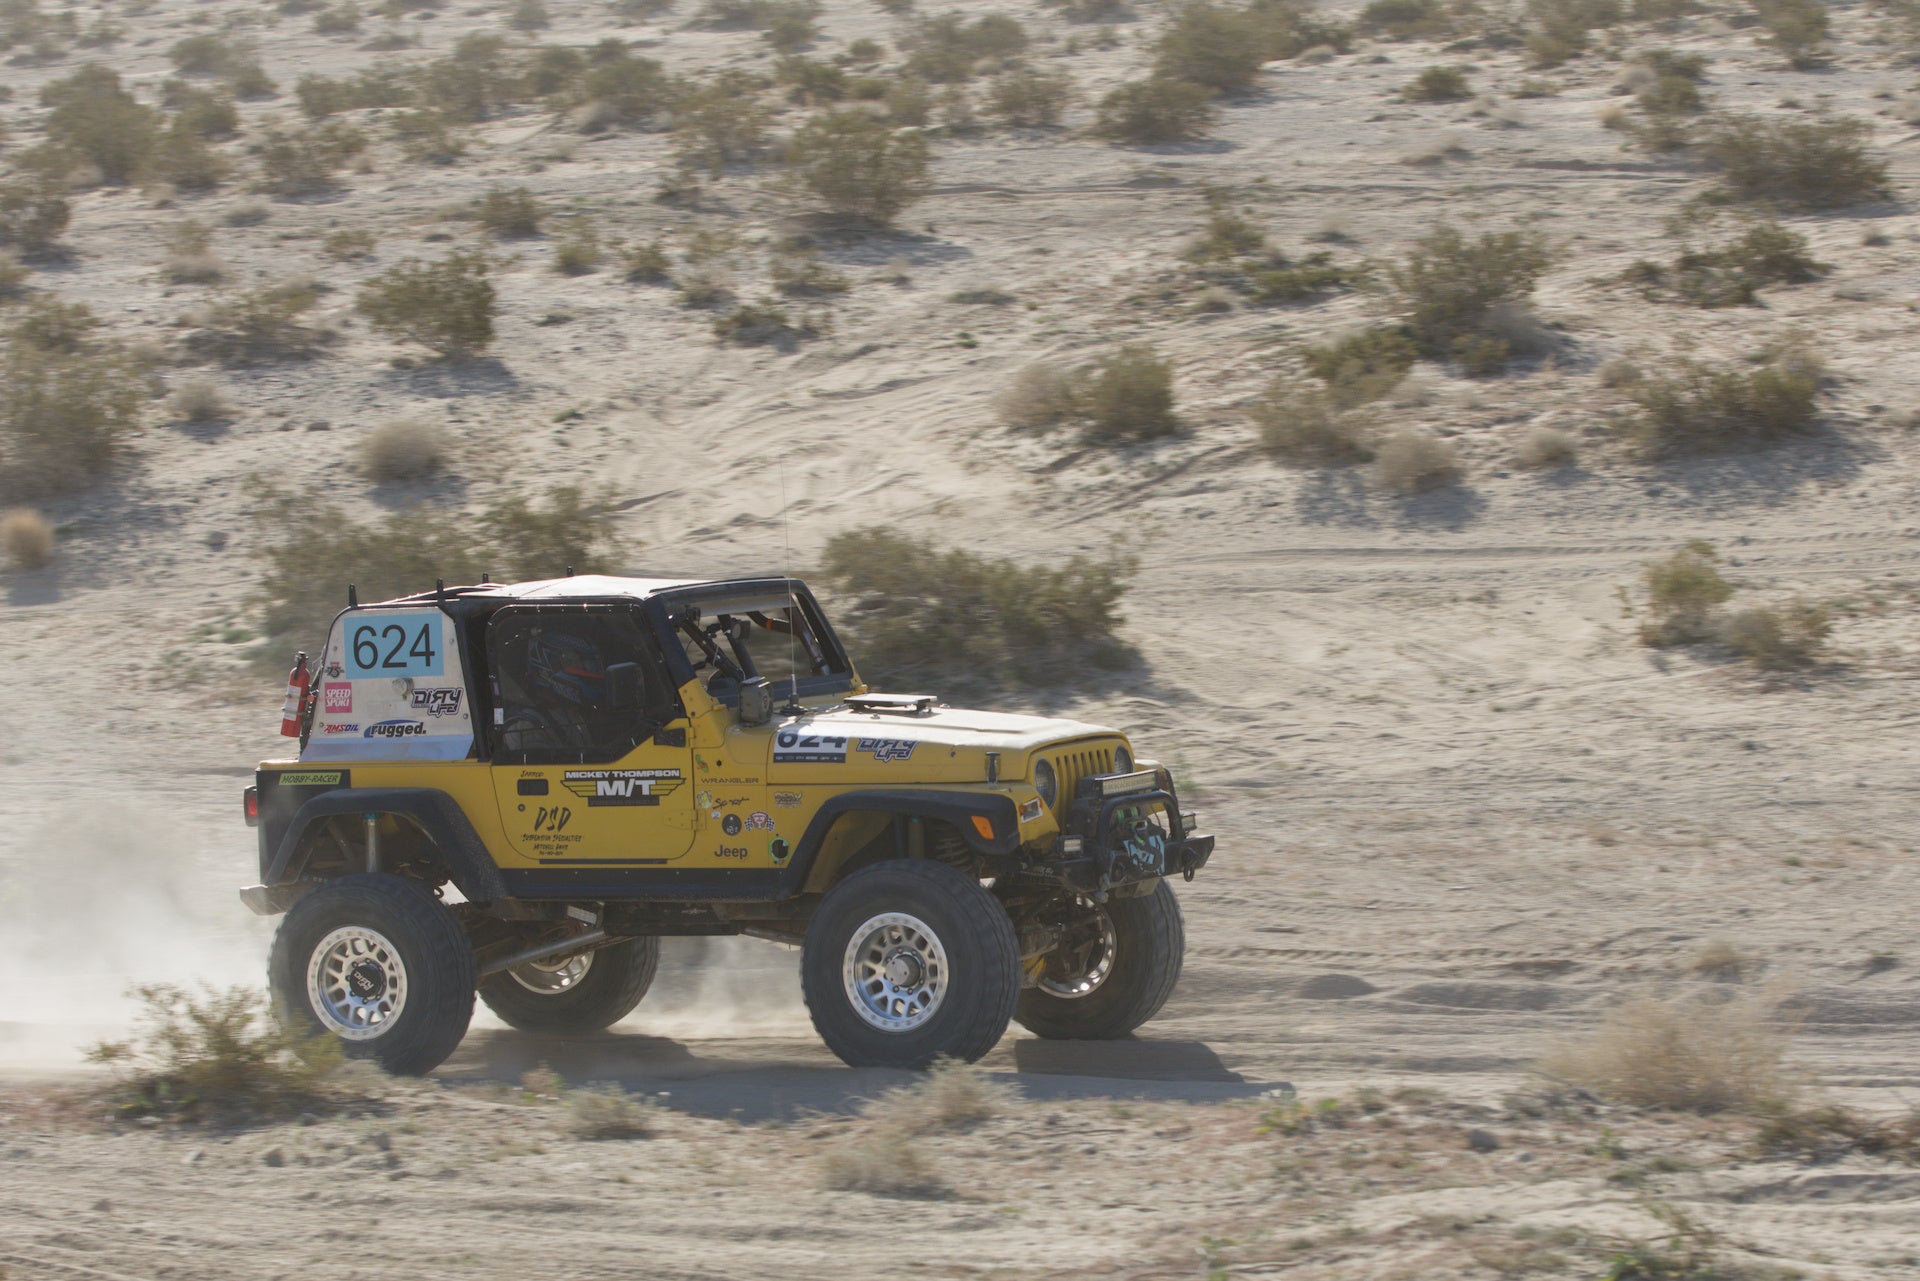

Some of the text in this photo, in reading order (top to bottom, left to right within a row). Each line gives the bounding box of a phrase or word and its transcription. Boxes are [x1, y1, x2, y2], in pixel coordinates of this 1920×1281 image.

[353, 623, 435, 670] 624
[326, 688, 351, 698] SPEED
[413, 689, 462, 704] DIRTY
[326, 698, 350, 707] SPORT
[429, 703, 458, 714] LIFE
[324, 724, 358, 733] AMSOIL
[371, 722, 427, 738] rugged.
[876, 748, 911, 761] LIFE
[282, 775, 339, 784] HOBBY-RACER
[612, 769, 680, 777] THOMPSON
[596, 778, 657, 797] M/T
[534, 806, 572, 832] DSD
[714, 844, 748, 859] Jeep
